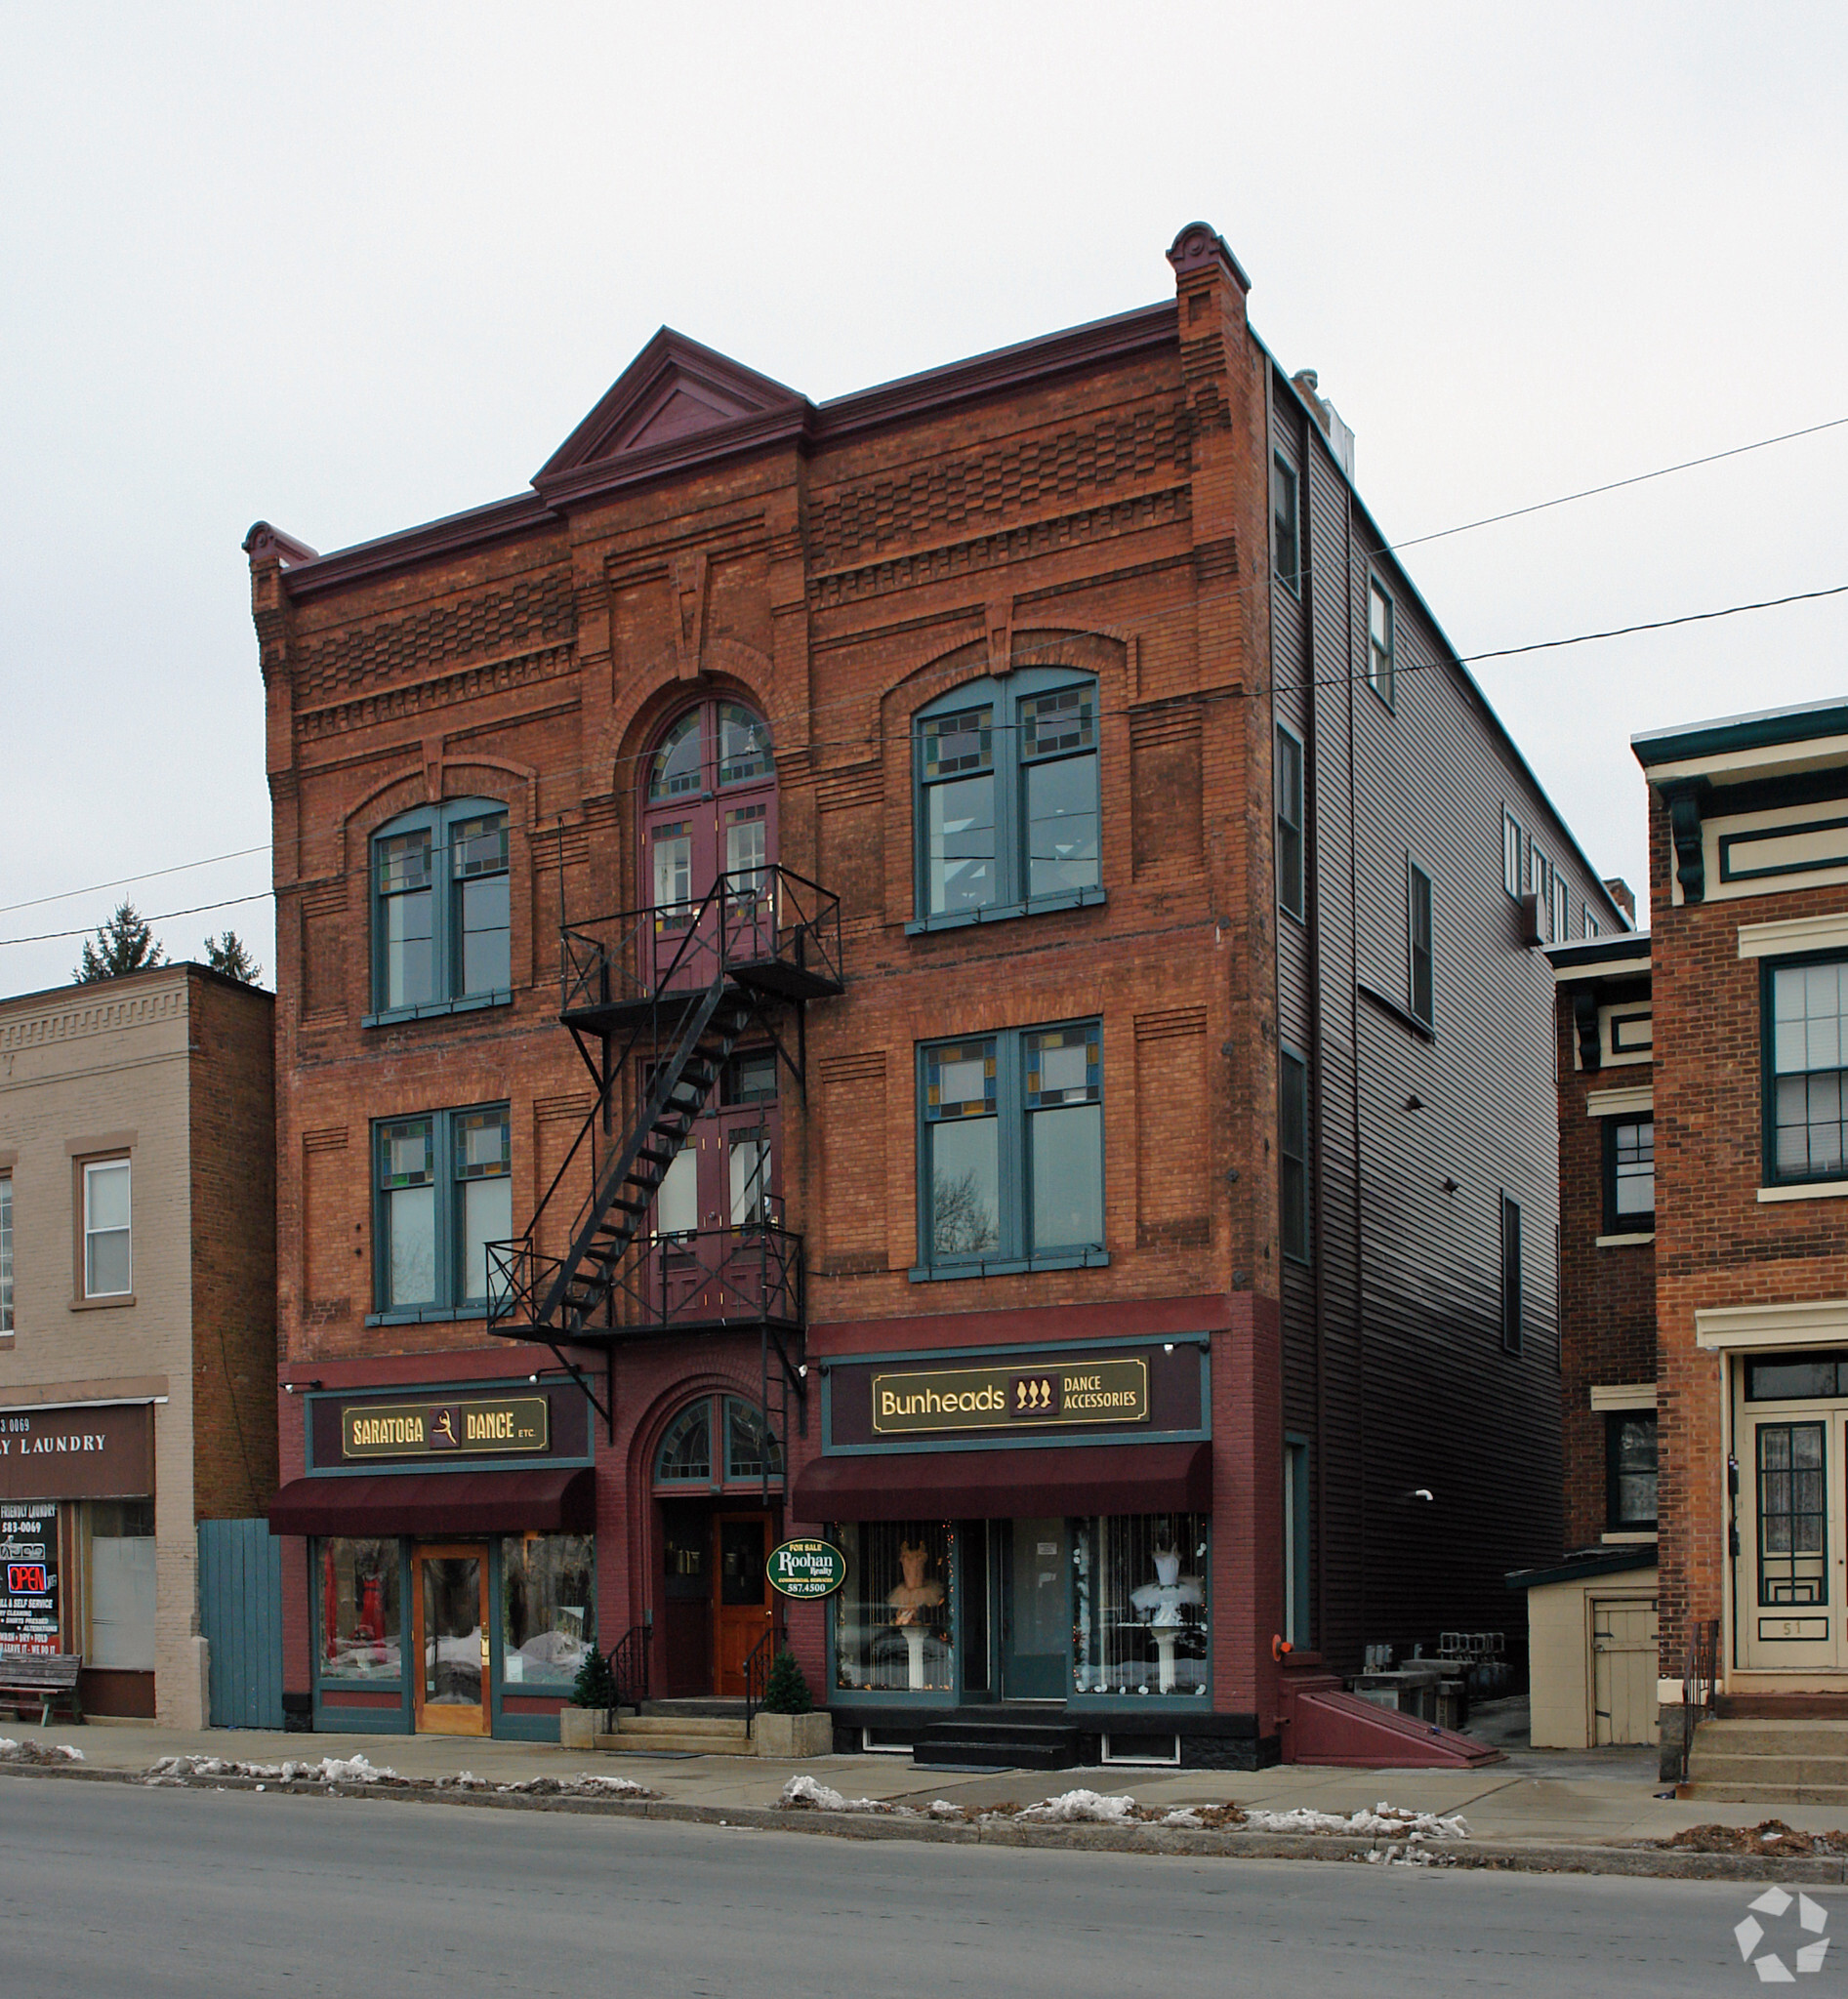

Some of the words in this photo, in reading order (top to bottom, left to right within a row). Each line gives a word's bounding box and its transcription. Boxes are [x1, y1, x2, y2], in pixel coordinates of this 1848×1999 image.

[1063, 1375, 1102, 1392] DANCE
[881, 1384, 1006, 1415] Bunheads
[1063, 1391, 1137, 1409] ACCESSORIES
[9, 1417, 30, 1433] 0069
[352, 1416, 425, 1445] SARATOGA
[467, 1411, 514, 1440] DANCE
[517, 1429, 537, 1438] ETC.
[21, 1434, 105, 1454] LAUNDRY
[1, 1504, 27, 1519] FRIENDLY
[28, 1503, 56, 1518] LAUNDRY
[2, 1521, 42, 1533] 583-0069
[789, 1543, 803, 1552] FOR
[778, 1551, 833, 1576] Roohan
[809, 1567, 833, 1576] Realty
[10, 1567, 44, 1591] OPEN
[787, 1583, 826, 1592] 587.4500
[13, 1598, 28, 1609] SELF
[28, 1598, 54, 1609] SERVICE
